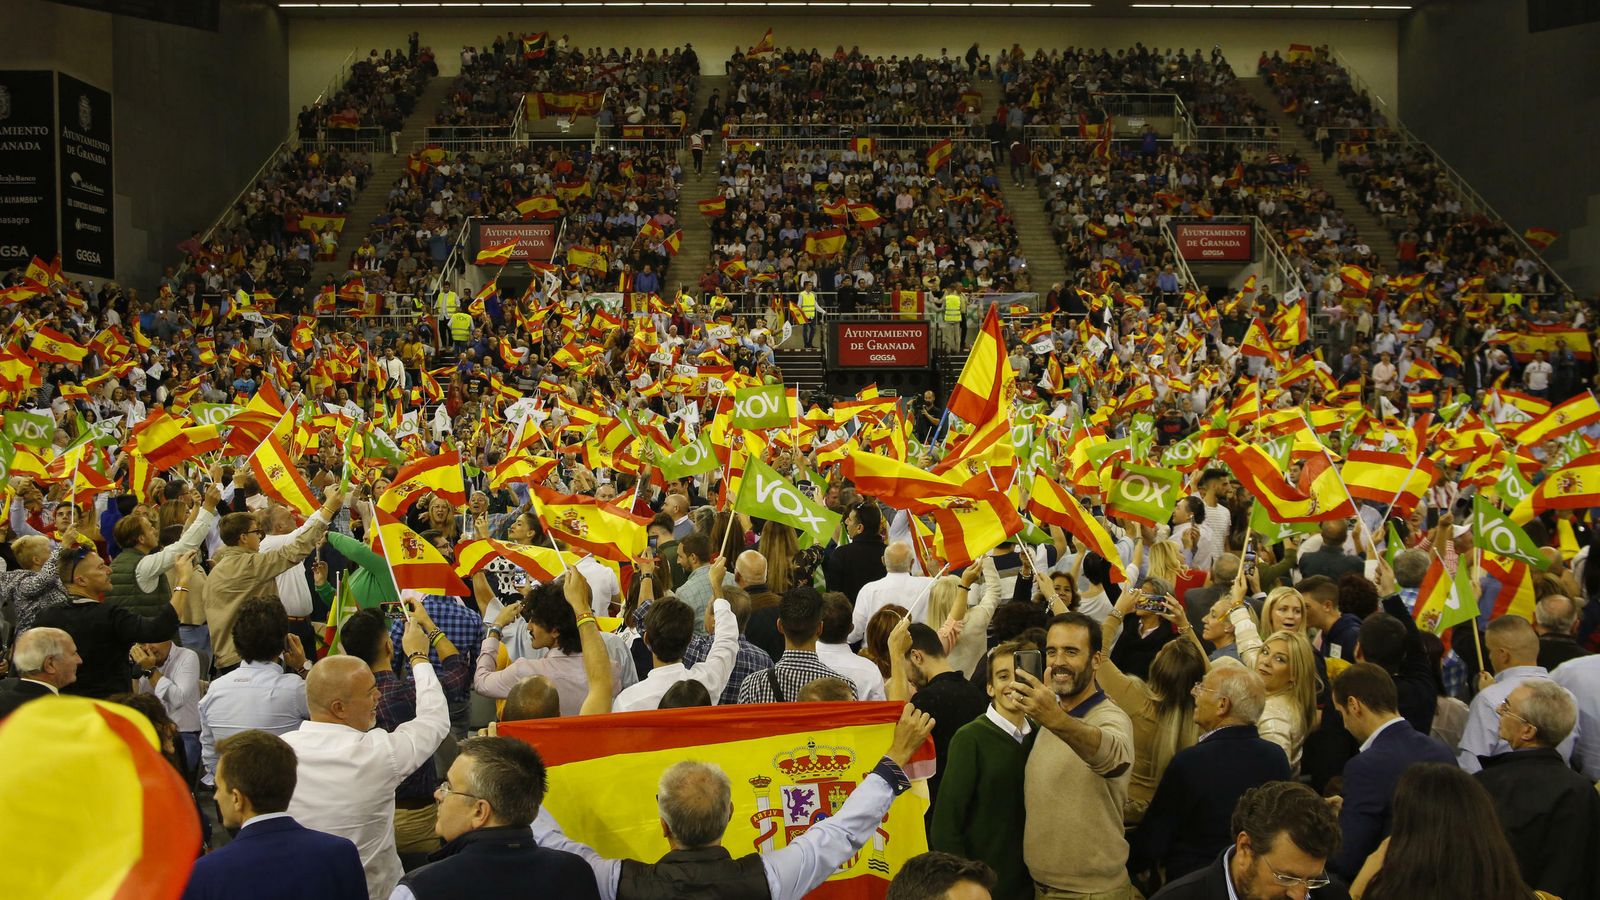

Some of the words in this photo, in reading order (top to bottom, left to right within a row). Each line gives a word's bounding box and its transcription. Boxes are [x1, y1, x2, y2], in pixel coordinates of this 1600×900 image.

[63, 126, 110, 152] AYUNTAMIENTO
[67, 144, 76, 156] DE
[76, 144, 107, 166] GRANADA
[485, 228, 551, 237] AYUNTAMIENTO
[1182, 228, 1247, 237] AYUNTAMIENTO
[1200, 237, 1241, 247] GRANADA
[844, 327, 922, 338] AYUNTAMIENTO
[850, 342, 864, 350] DE
[866, 339, 916, 350] GRANADA
[12, 418, 49, 440] VOX
[756, 474, 827, 533] VOX
[1478, 511, 1539, 565] VOX
